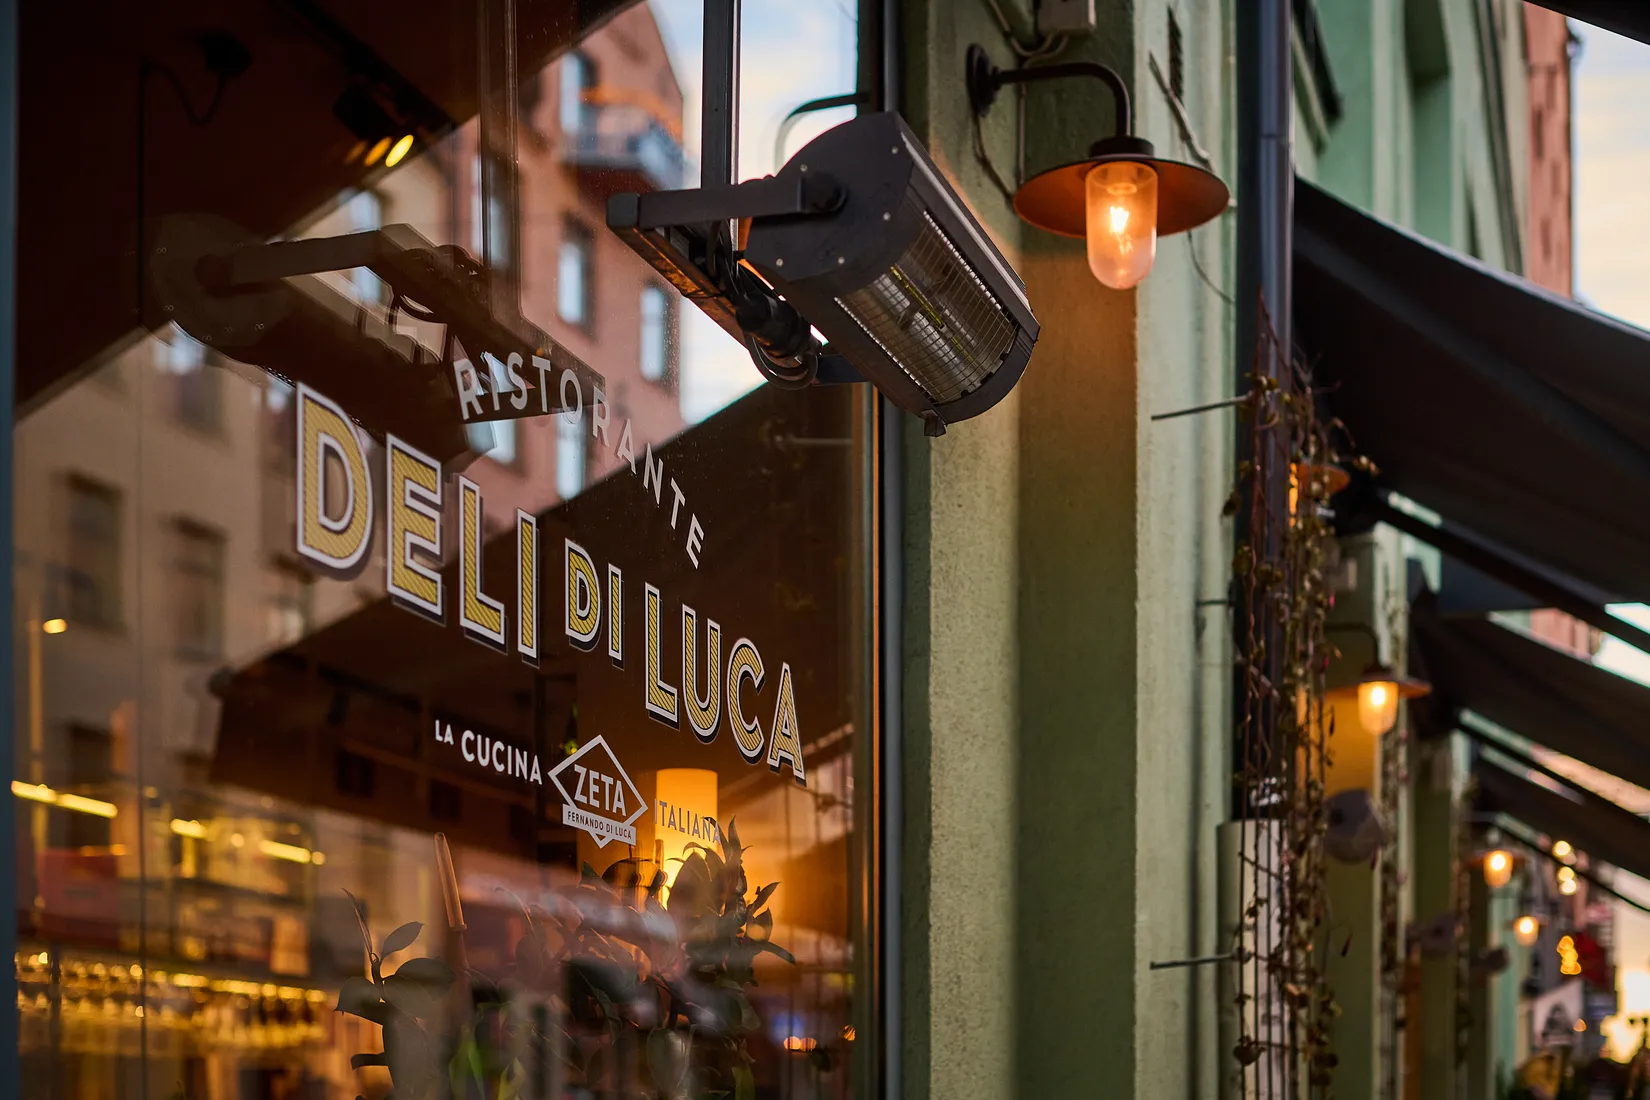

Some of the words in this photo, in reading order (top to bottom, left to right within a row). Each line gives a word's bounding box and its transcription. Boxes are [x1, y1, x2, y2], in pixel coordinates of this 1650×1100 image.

[454, 352, 704, 569] RISTORANTE
[297, 381, 540, 668] DELI
[565, 537, 625, 670] DI
[644, 581, 806, 787] LUCA
[435, 719, 454, 746] LA
[461, 729, 542, 785] CUCINA
[654, 798, 722, 846] ITALIANA
[567, 811, 604, 830] FERNANDO
[606, 824, 613, 834] DI
[615, 827, 631, 839] LUCA
[574, 763, 626, 817] ZETA
